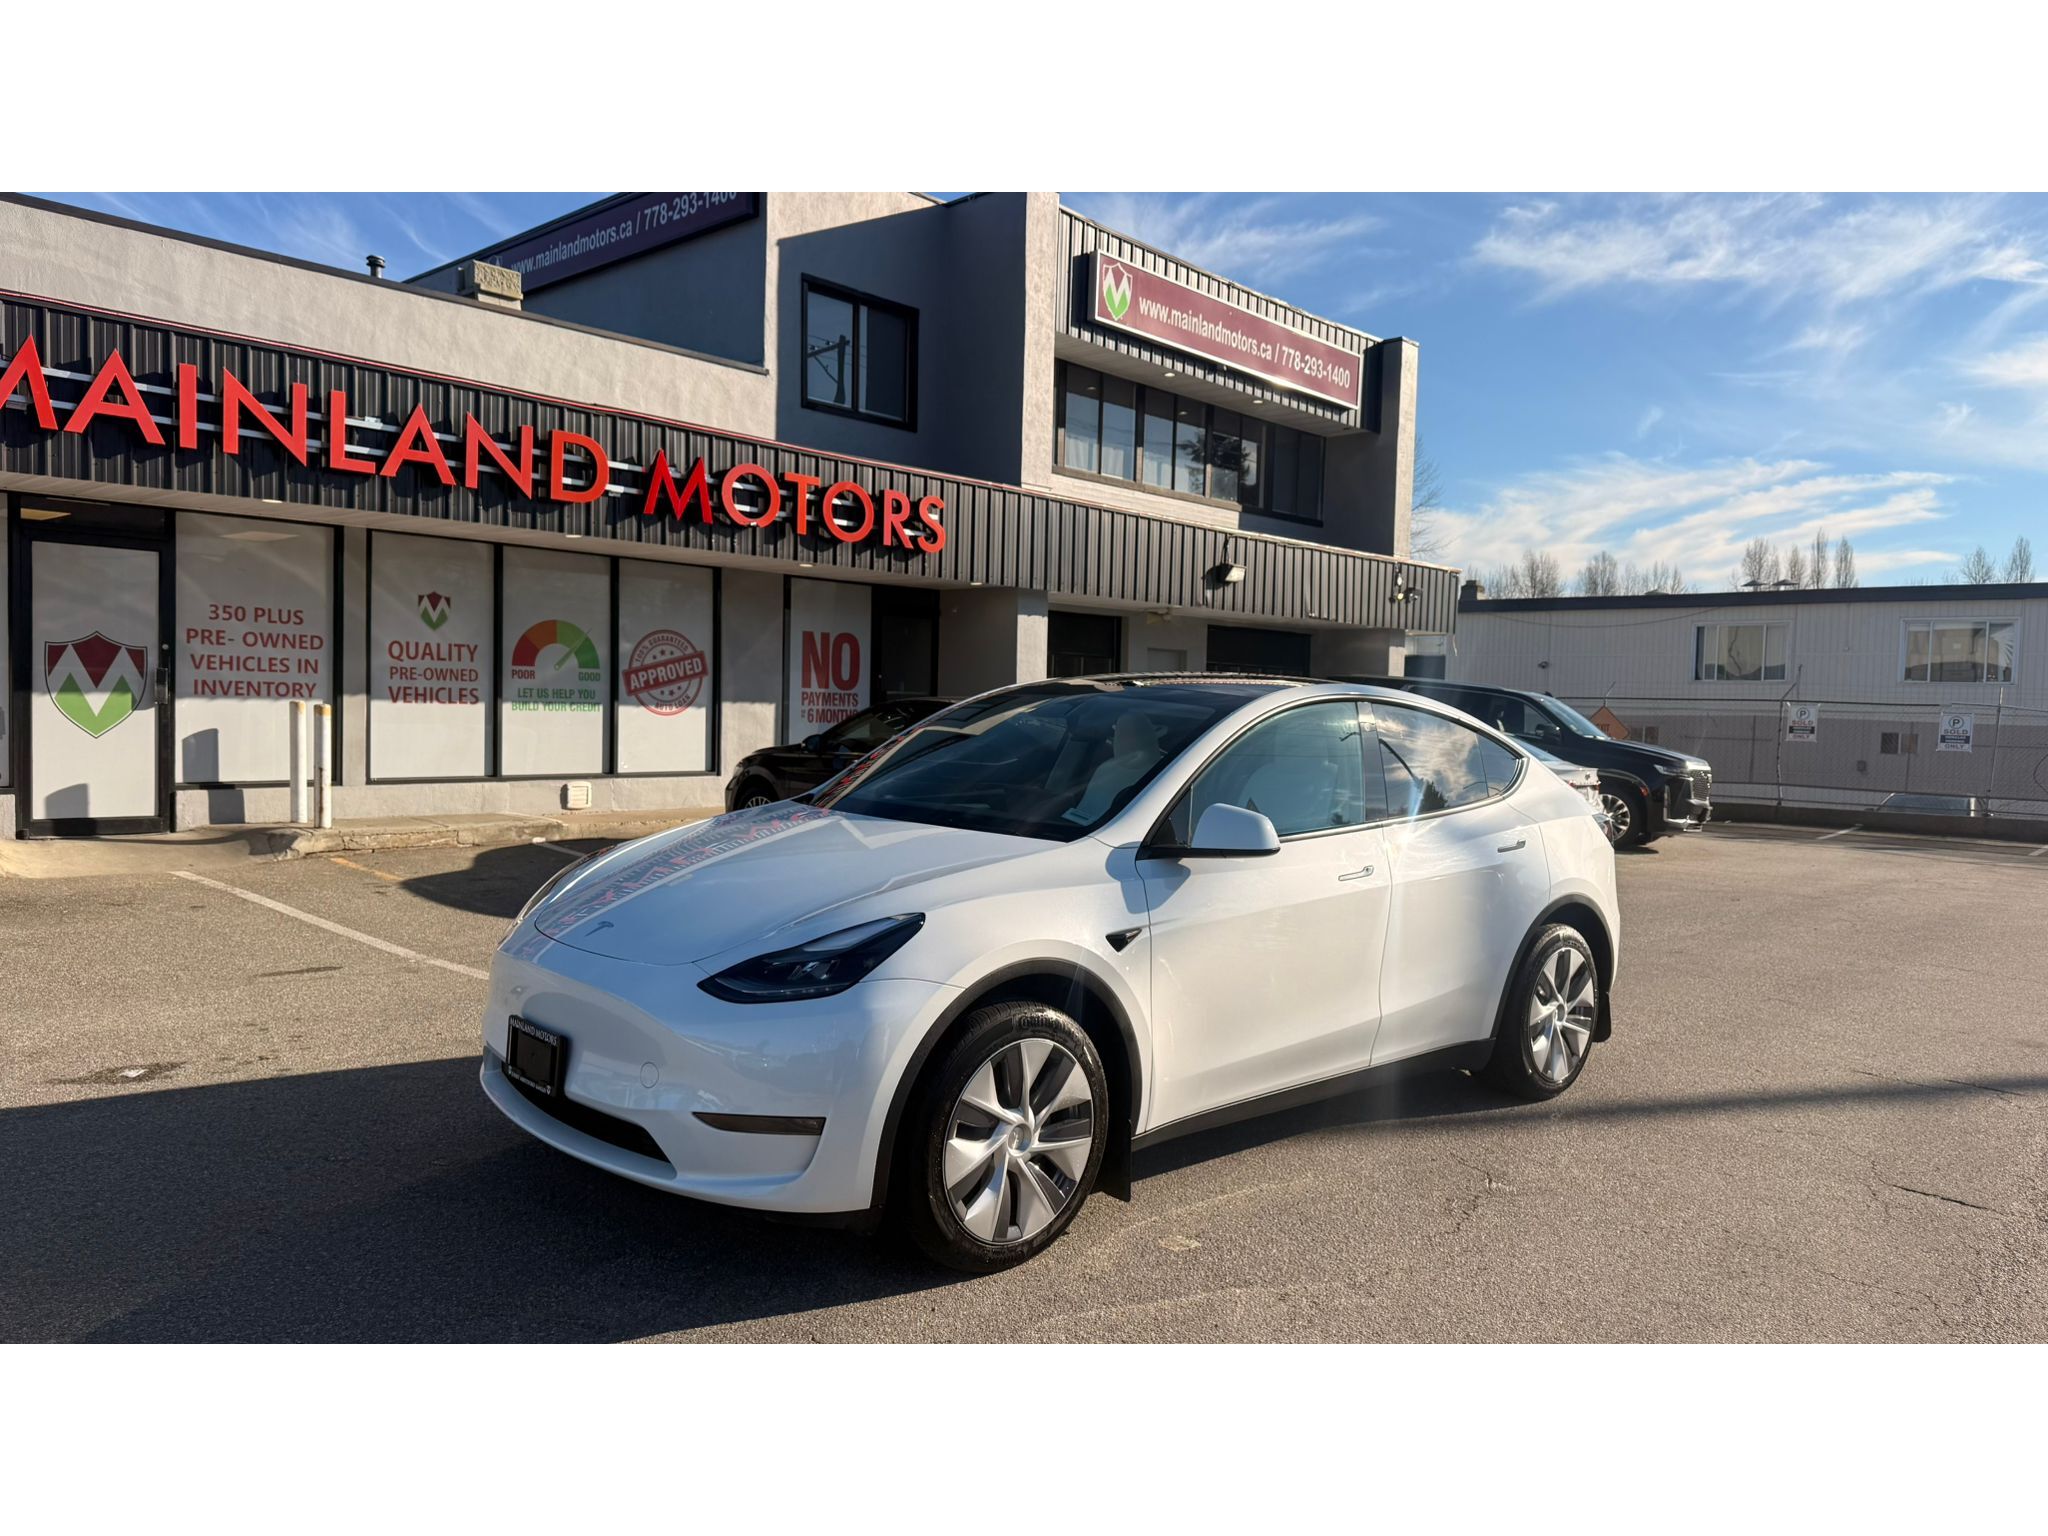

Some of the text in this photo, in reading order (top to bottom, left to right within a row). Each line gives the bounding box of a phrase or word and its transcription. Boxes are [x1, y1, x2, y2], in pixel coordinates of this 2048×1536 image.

[511, 220, 632, 274] www.mainlandmotors.ca
[635, 211, 641, 235] /
[1139, 297, 1350, 389] www.mainlandmotors.ca / 778-293-1400
[643, 448, 946, 553] MOTORS
[209, 604, 304, 625] 350 PLUS
[186, 628, 324, 650] PRE- OWNED
[388, 640, 479, 662] QUALITY
[190, 654, 319, 674] VEHICLES IN
[801, 631, 860, 691] NO
[389, 666, 479, 682] PRE-OWNED
[511, 669, 536, 680] POOR
[578, 671, 601, 682] GOOD
[630, 657, 703, 690] APPROVED
[193, 679, 317, 698] INVENTORY
[388, 686, 480, 705] VEHICLES
[517, 688, 596, 699] LET US HELP YOU
[511, 700, 601, 713] BUILD YOUR CREDIT
[655, 693, 691, 711] AUTO LOAN
[801, 691, 859, 707] PAYMENTS
[807, 708, 814, 723] 6
